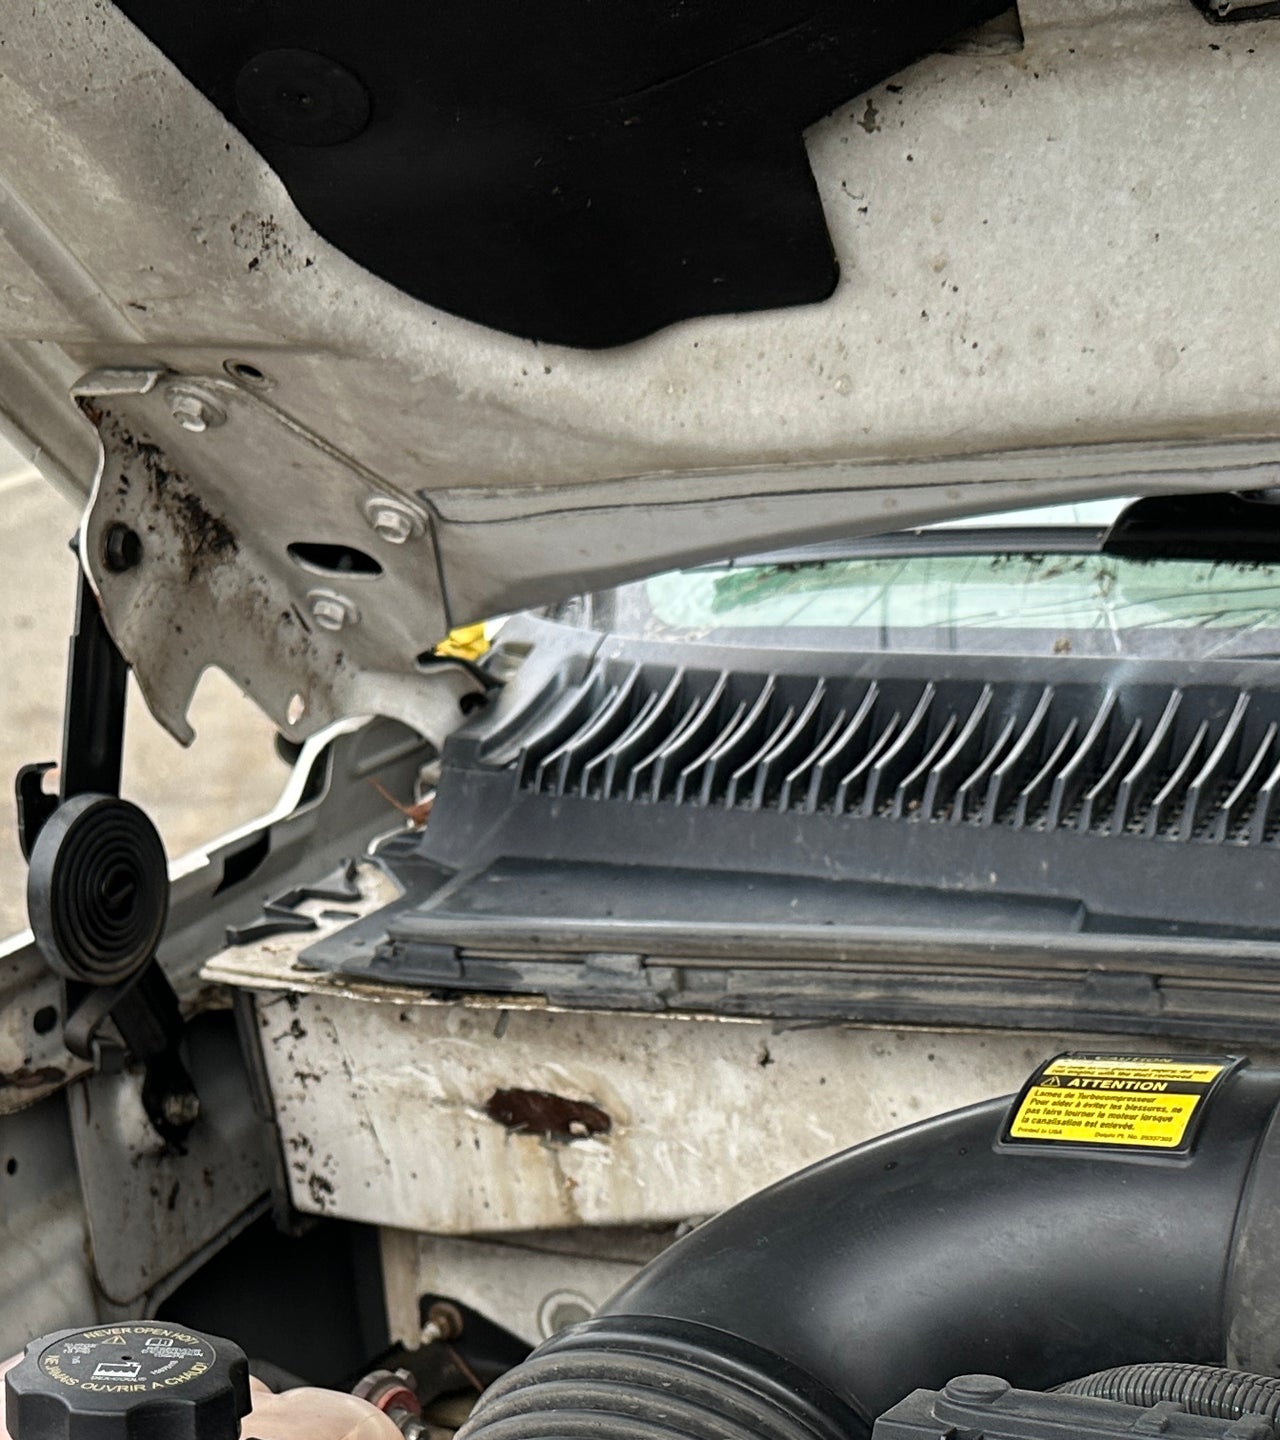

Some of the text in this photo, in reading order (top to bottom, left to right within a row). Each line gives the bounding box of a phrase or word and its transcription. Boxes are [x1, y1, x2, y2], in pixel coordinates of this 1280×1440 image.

[1067, 1078, 1168, 1091] ATTENTION
[83, 1327, 132, 1338] NEVER
[134, 1327, 173, 1337] OPEN
[80, 1382, 147, 1392] OUVRIR
[152, 1381, 165, 1389] A
